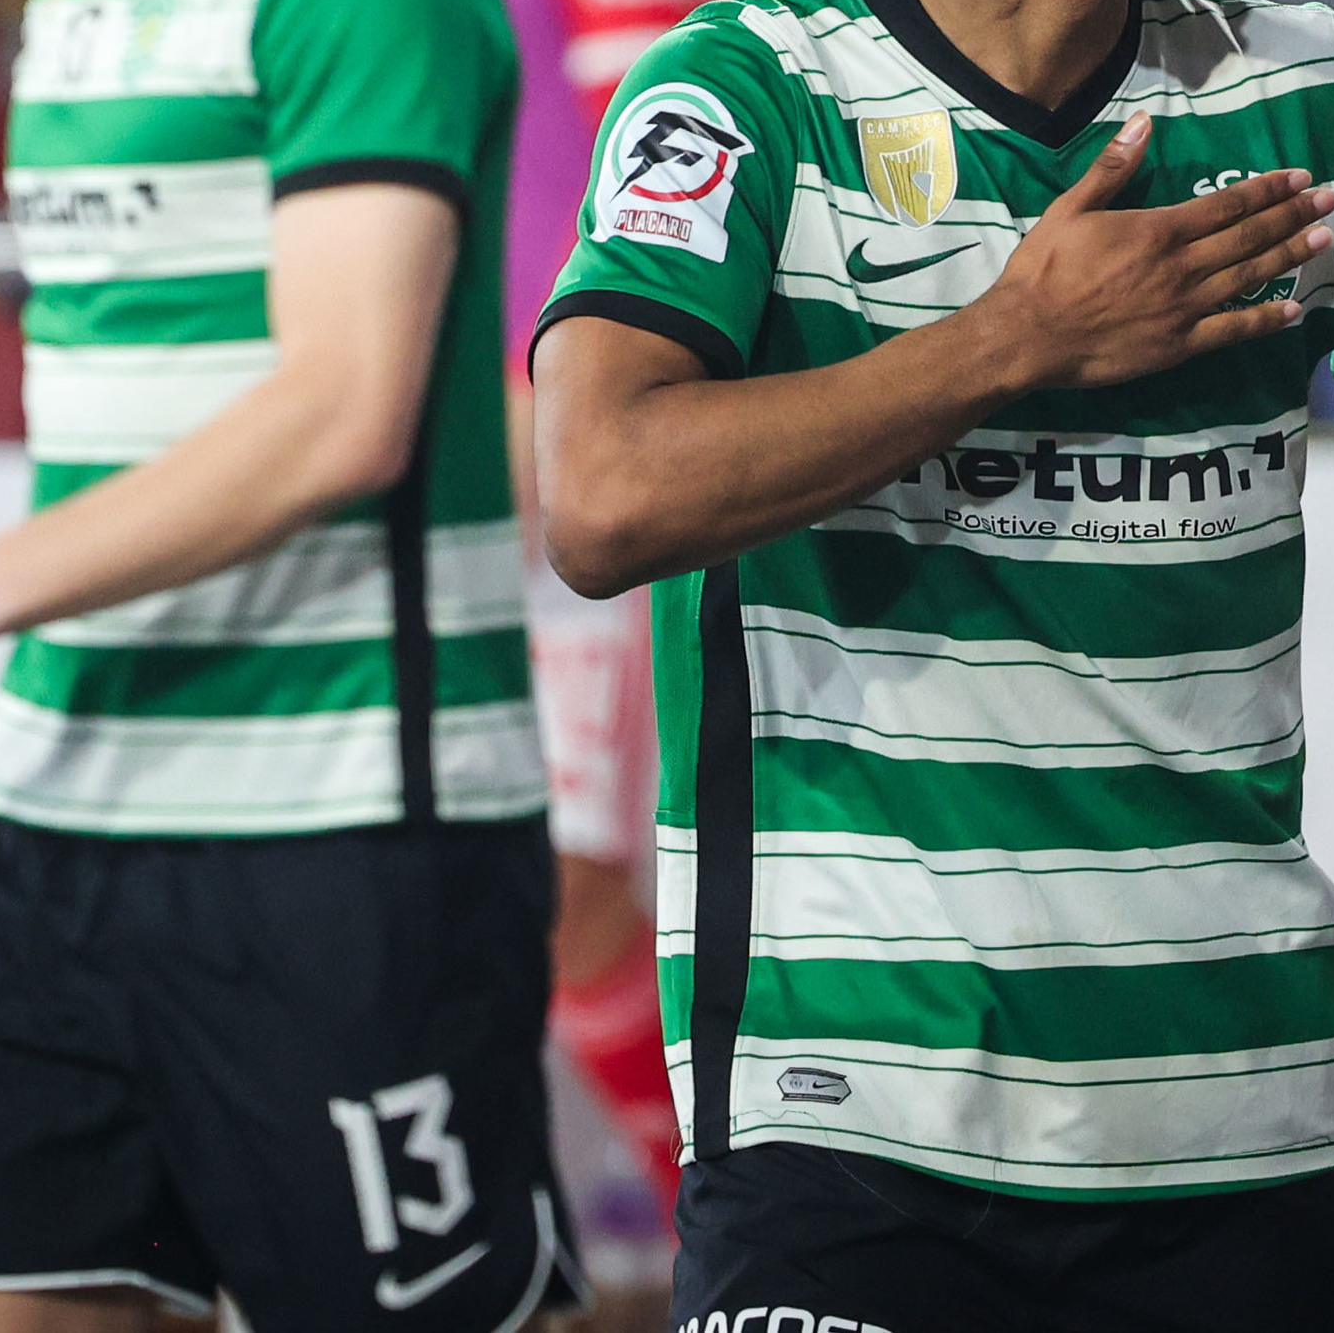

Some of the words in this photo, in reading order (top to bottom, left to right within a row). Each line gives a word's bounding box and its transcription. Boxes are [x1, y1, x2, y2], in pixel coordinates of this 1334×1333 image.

[1192, 170, 1265, 197] SC
[614, 209, 693, 243] PLACARD
[1071, 519, 1166, 543] digital
[1178, 517, 1236, 537] flow
[328, 1073, 475, 1253] 13
